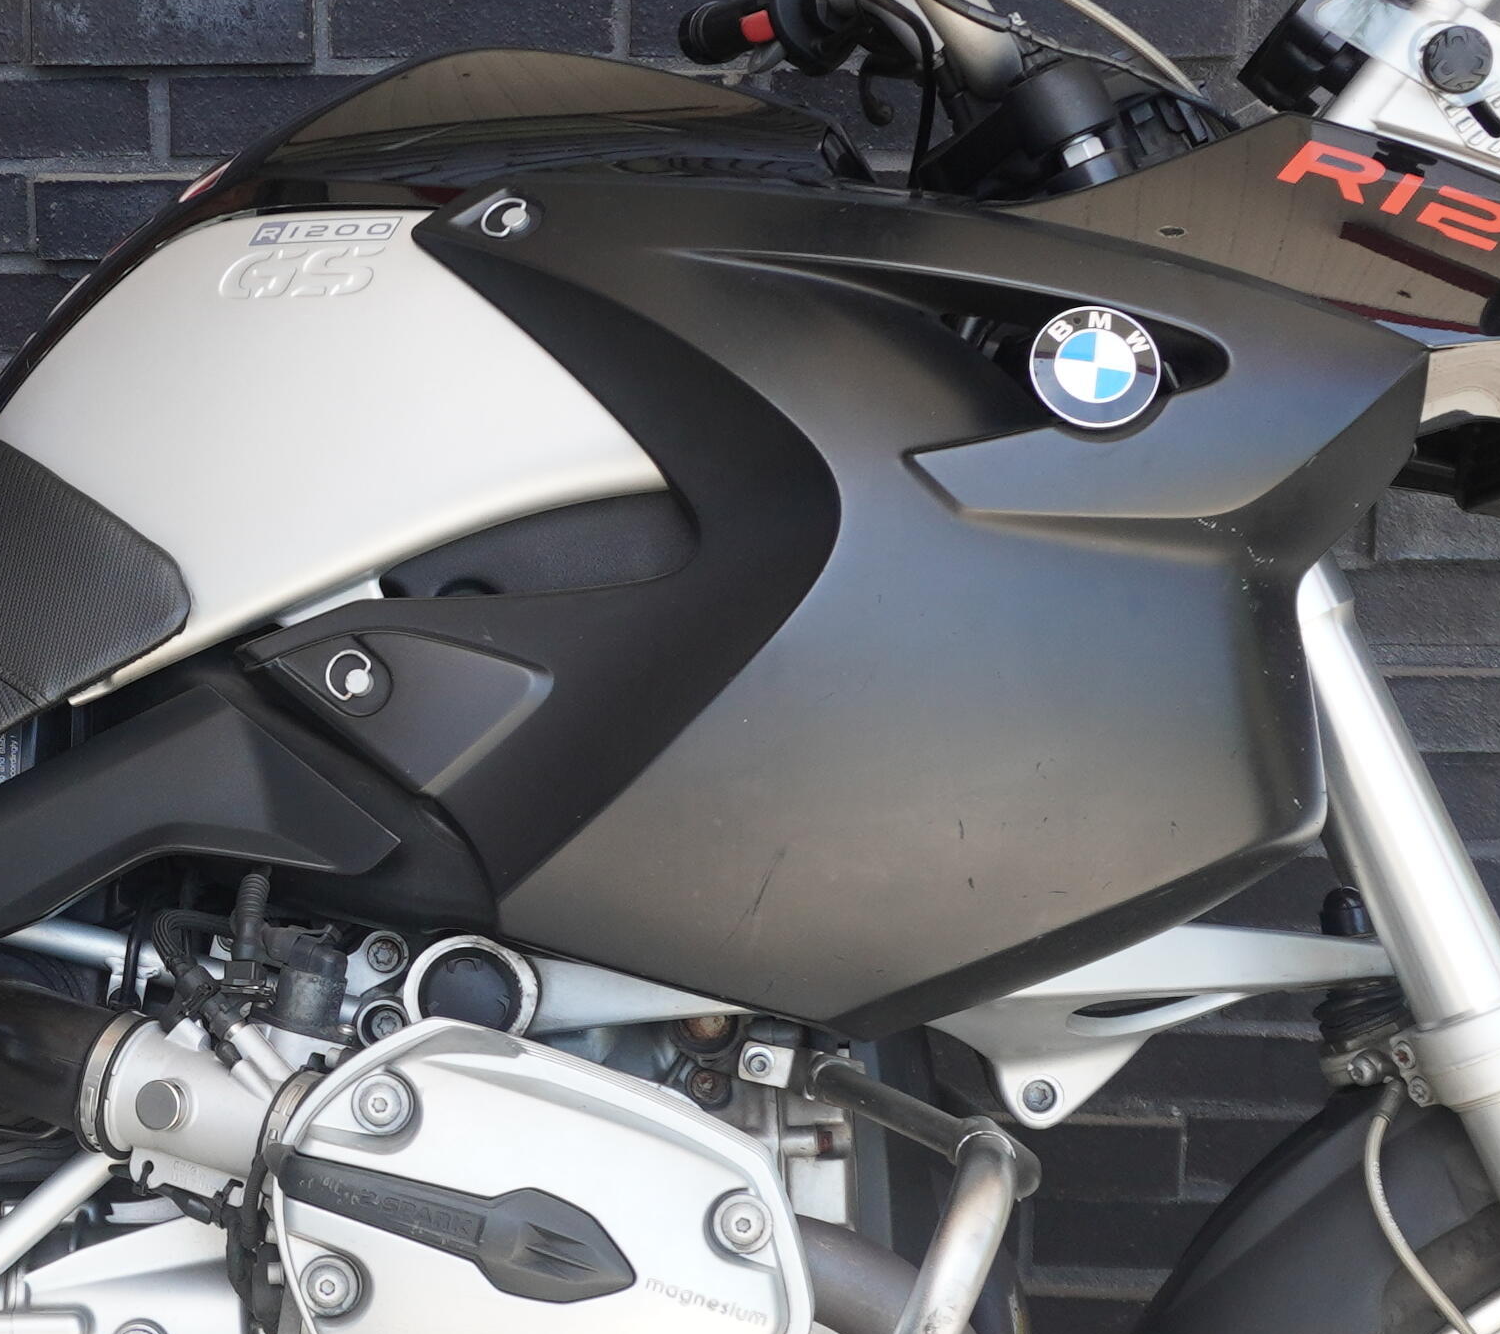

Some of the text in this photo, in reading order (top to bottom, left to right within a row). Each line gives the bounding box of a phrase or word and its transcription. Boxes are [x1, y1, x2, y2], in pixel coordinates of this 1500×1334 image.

[256, 223, 392, 242] R1200
[218, 245, 386, 299] GS
[1047, 311, 1151, 354] BMW
[645, 1277, 767, 1327] magnesium
